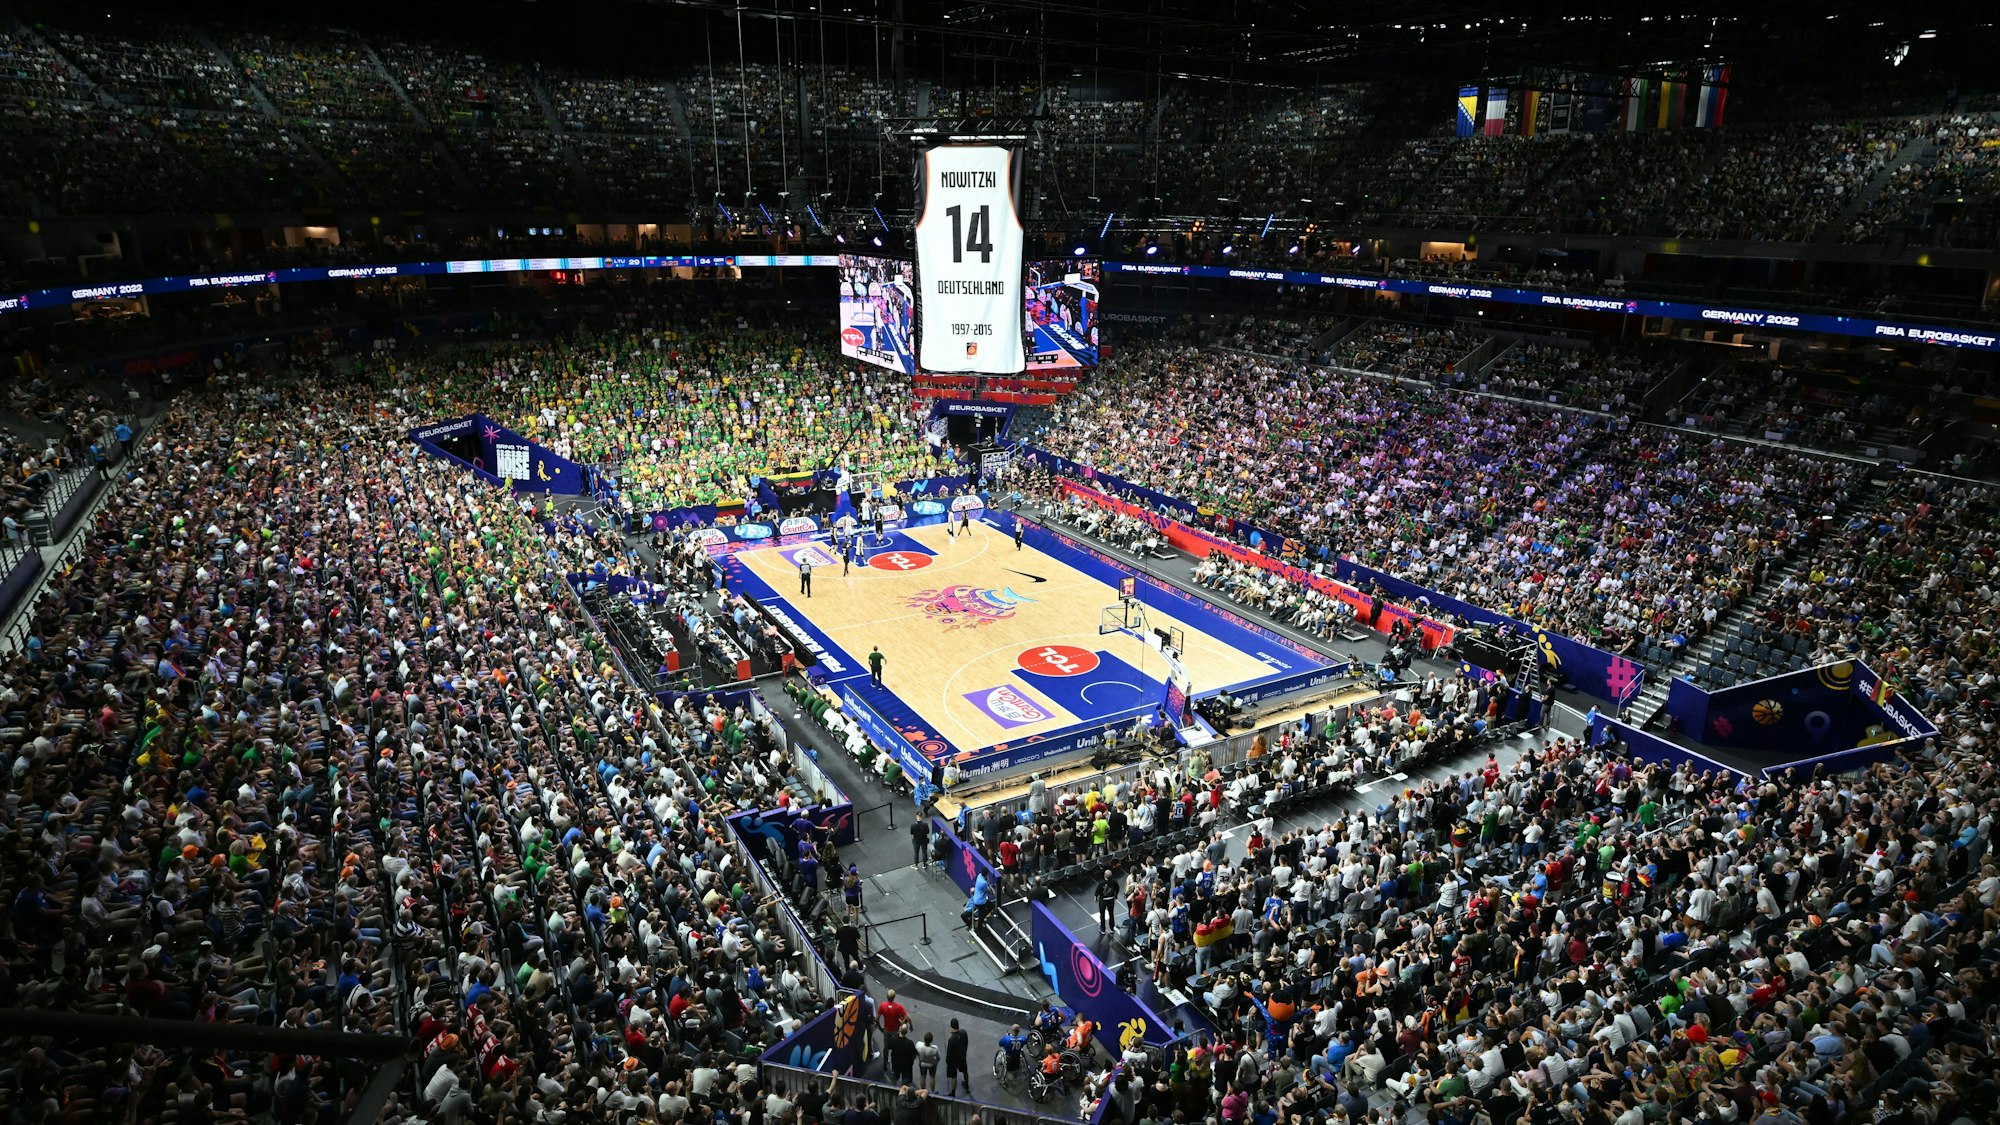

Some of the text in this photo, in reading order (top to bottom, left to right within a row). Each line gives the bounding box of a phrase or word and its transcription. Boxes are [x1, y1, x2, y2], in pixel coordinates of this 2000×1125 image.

[941, 171, 996, 188] NOWITZKI
[946, 204, 993, 263] 14
[328, 266, 397, 277] GERMANY 2022
[1138, 265, 1181, 273] EUROBASKET
[1229, 270, 1284, 280] GERMANY 2022
[189, 274, 265, 287] FIBA EUROBASKET
[938, 280, 1004, 295] DEUTSCHLAND
[1321, 276, 1378, 287] FIBA EUROBASKET
[72, 284, 143, 299] GERMANY 2022
[1429, 285, 1492, 298] GERMANY 2022
[1542, 295, 1624, 310] FIBA EUROBASKET
[1702, 309, 1799, 327] GERMANY 2022
[842, 333, 864, 341] TCL
[951, 323, 993, 336] 1997-2015
[1875, 325, 1995, 347] FIBA EUROBASKET
[949, 404, 1008, 413] #EUROBASKET
[418, 420, 473, 439] #EUROBASKET
[1190, 529, 1229, 549] EUROBASKET
[1231, 545, 1247, 556] 2022
[887, 553, 917, 570] TCL
[1342, 588, 1444, 632] FIBA EUBASKE 2022
[763, 605, 847, 673] FIBA EUROBASKET
[1038, 647, 1079, 673] TCL
[1309, 671, 1343, 687] Unilumin
[1859, 680, 1921, 737] #EOBASKE
[1076, 734, 1100, 749] Unil
[959, 765, 991, 779] ilumin
